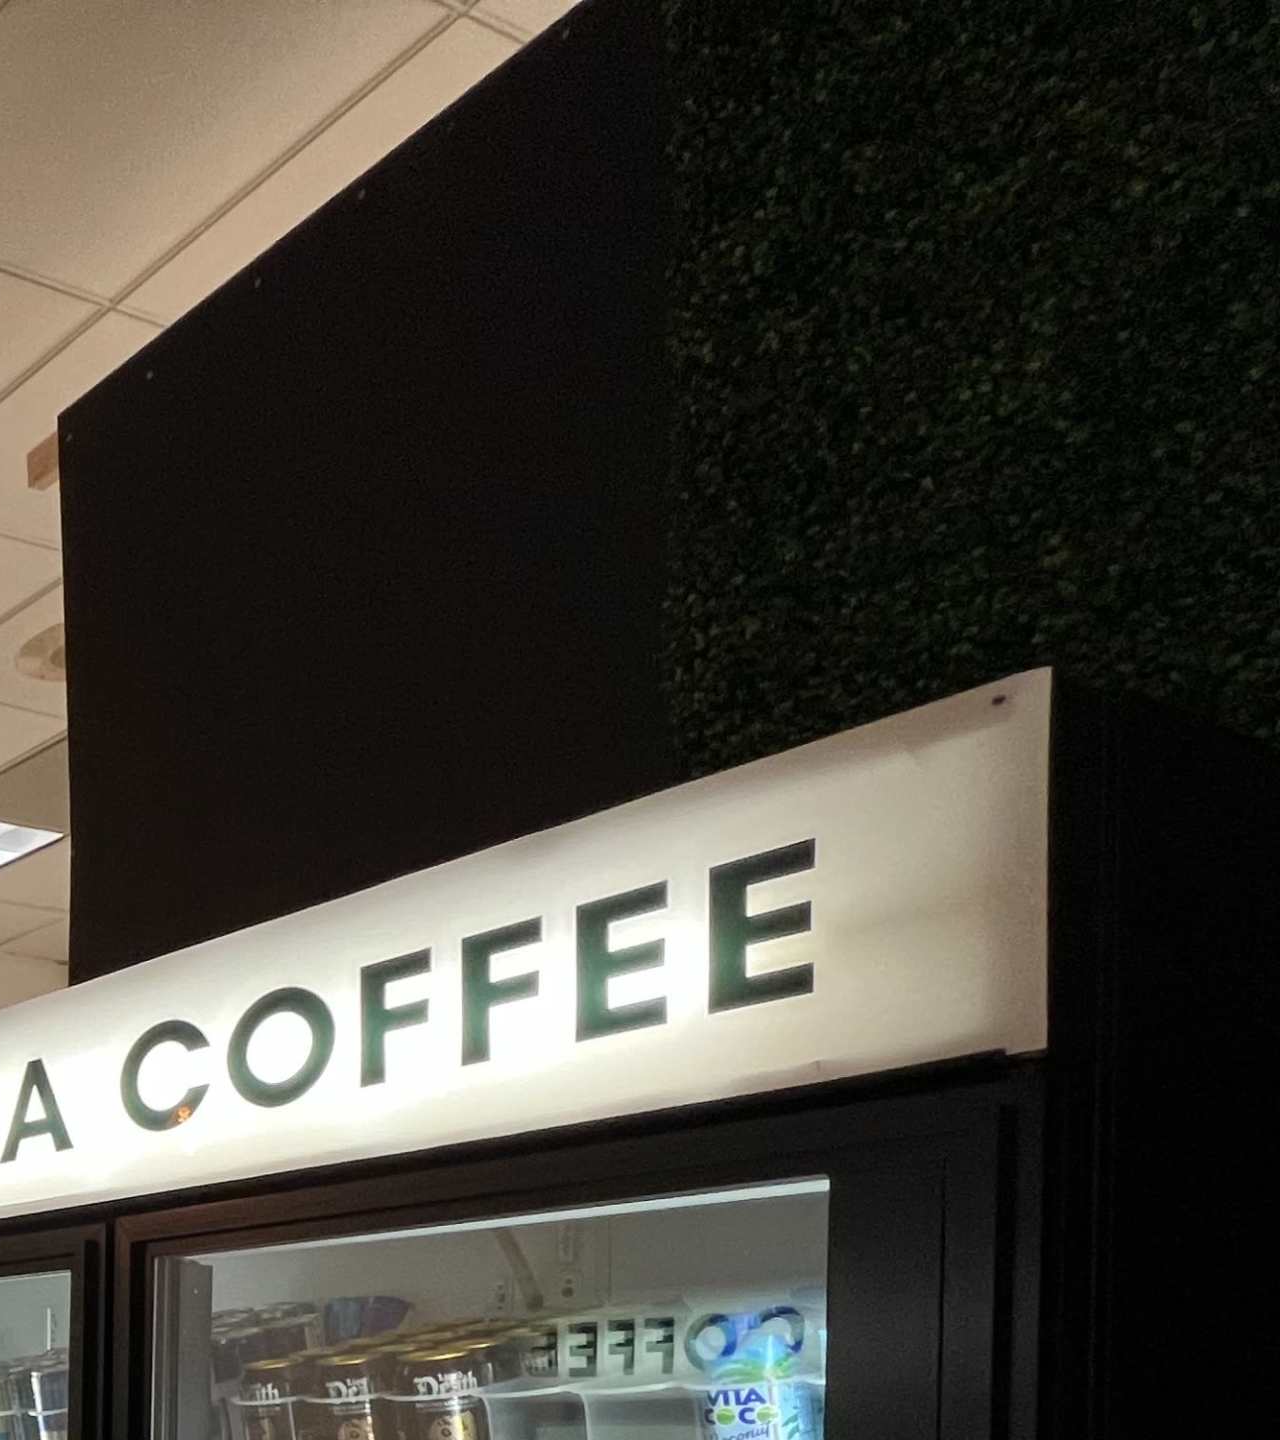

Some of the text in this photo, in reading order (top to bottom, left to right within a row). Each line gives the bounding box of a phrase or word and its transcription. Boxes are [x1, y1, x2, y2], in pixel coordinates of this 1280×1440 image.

[120, 837, 817, 1132] COFFEE
[705, 1387, 766, 1406] VITA
[704, 1407, 777, 1426] COCO
